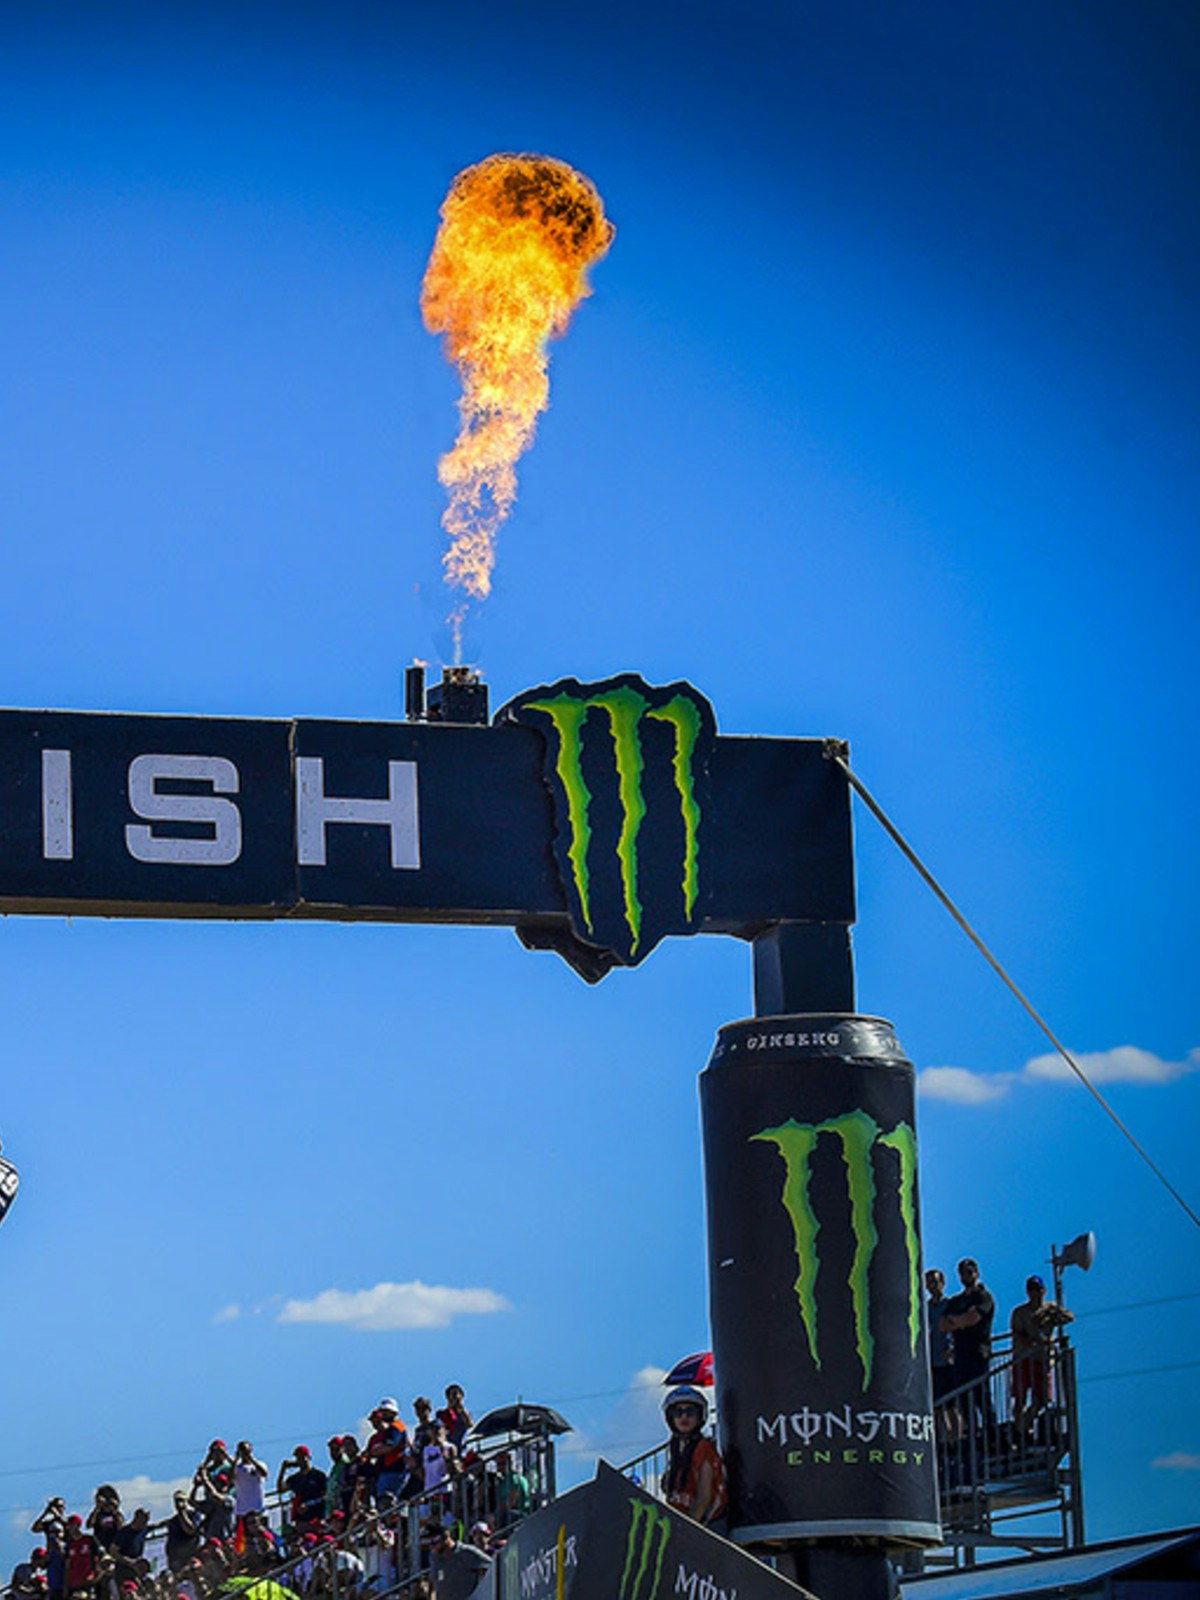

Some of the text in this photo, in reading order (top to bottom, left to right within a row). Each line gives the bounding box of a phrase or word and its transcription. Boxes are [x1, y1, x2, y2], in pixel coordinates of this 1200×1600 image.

[746, 1032, 839, 1049] GINSENG
[757, 1404, 935, 1446] MONSTER
[787, 1450, 924, 1466] ENERGY
[521, 1535, 578, 1598] MONSTR
